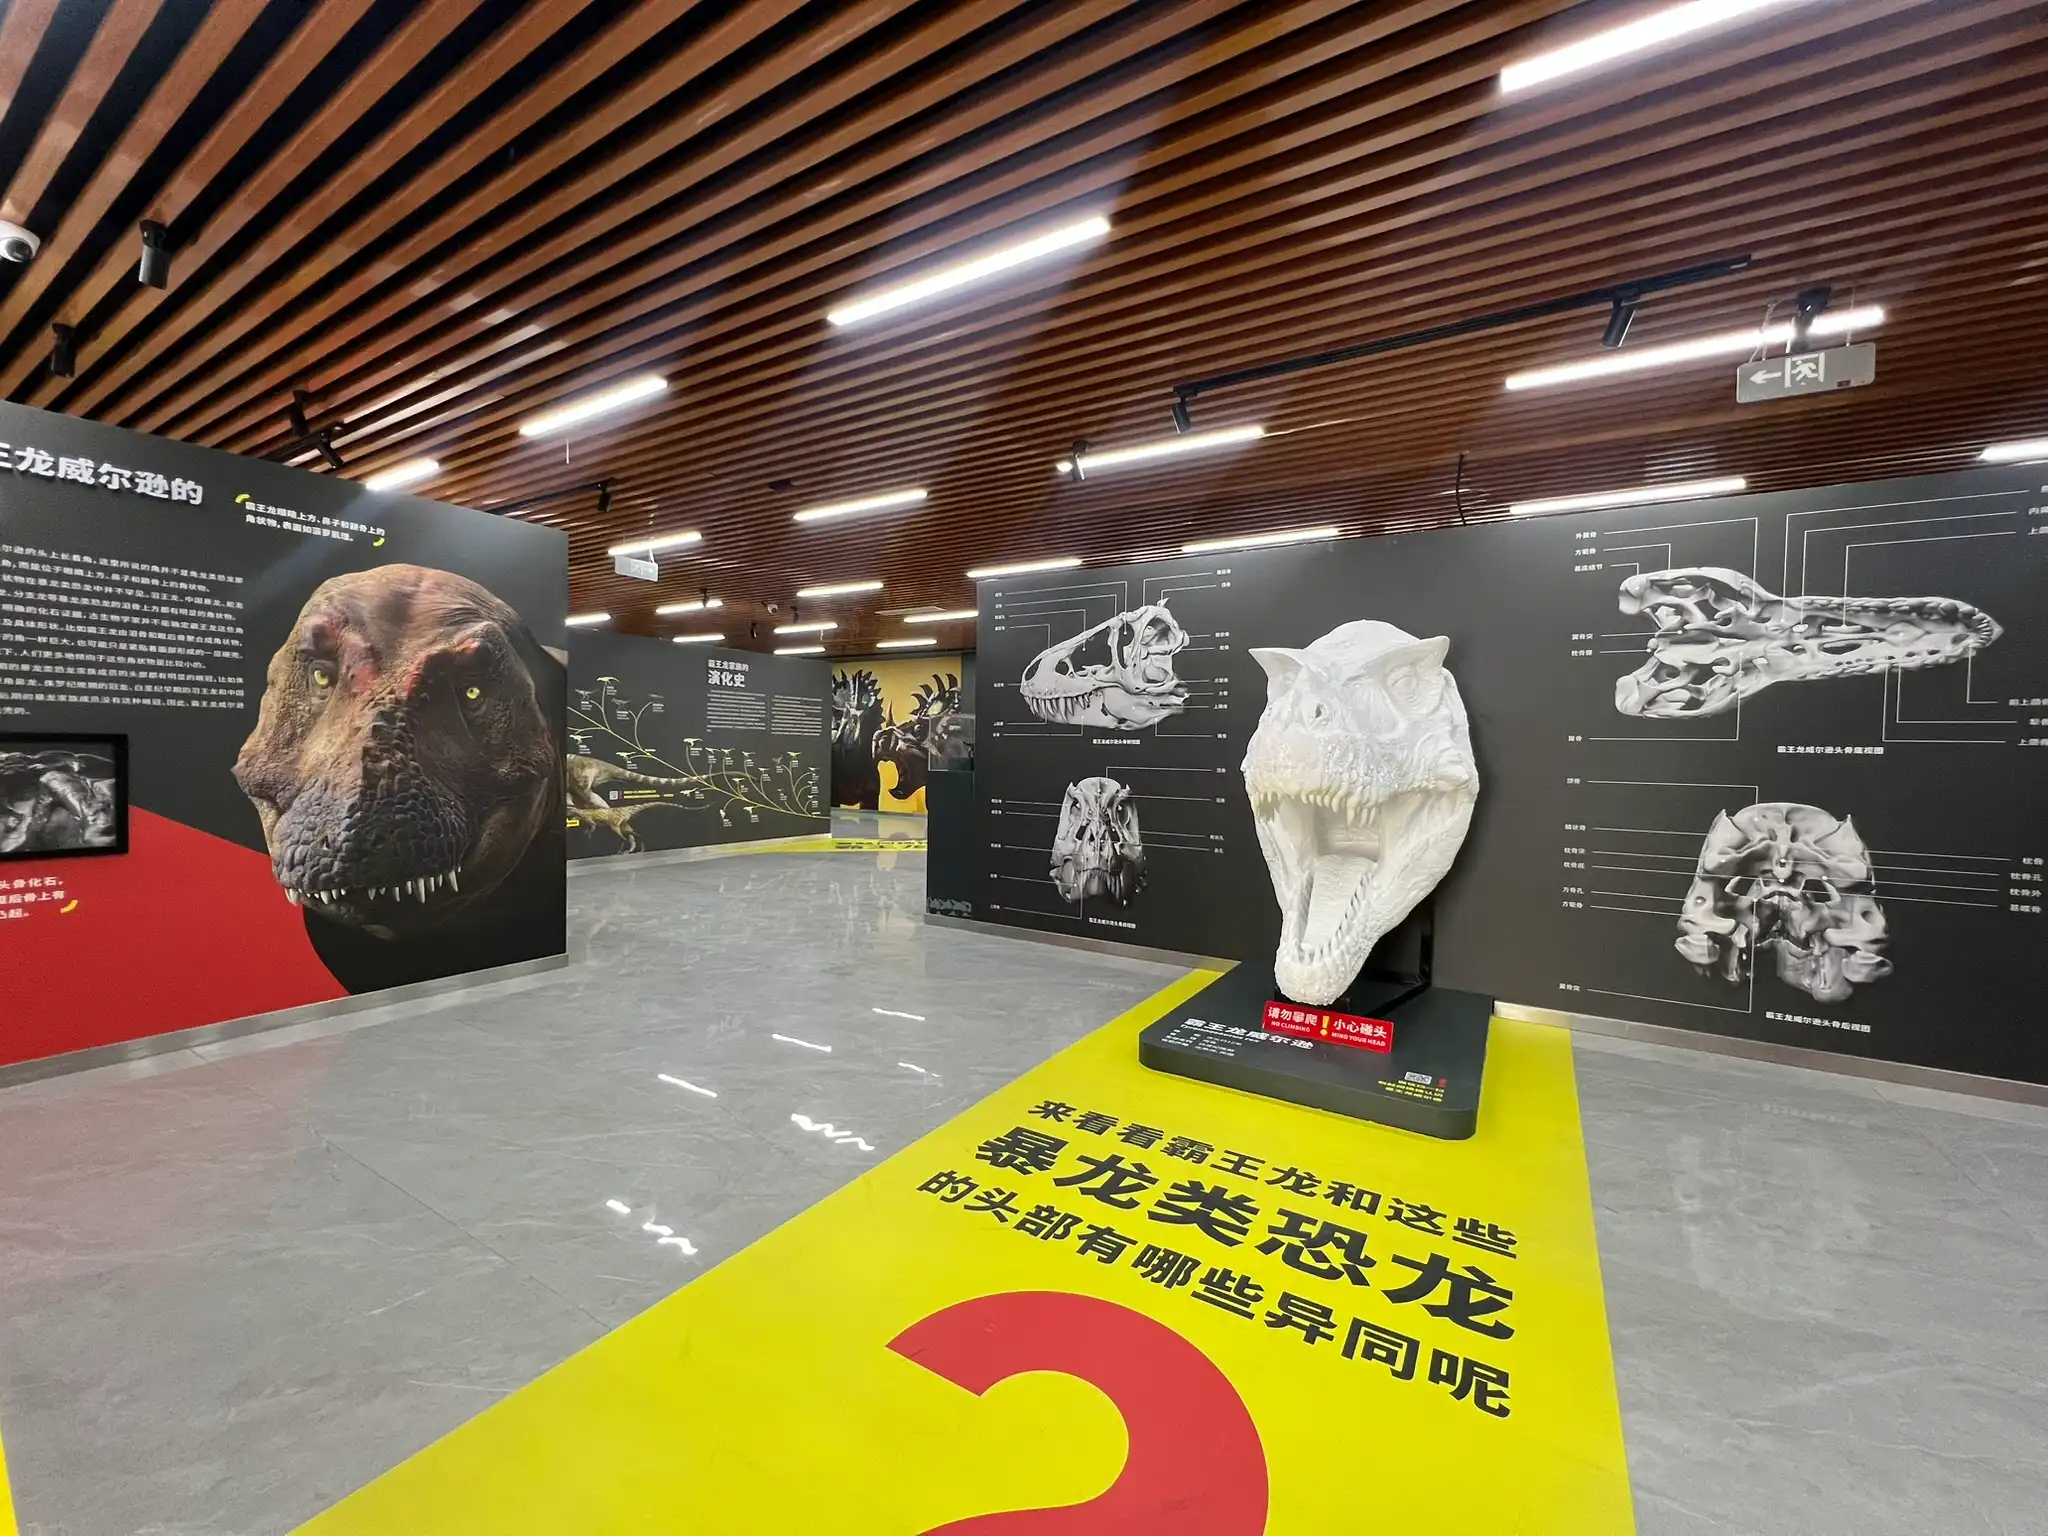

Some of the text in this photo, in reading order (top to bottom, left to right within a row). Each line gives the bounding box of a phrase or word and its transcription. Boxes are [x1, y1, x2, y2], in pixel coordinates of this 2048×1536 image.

[708, 670, 746, 688] 演化史
[1776, 745, 1885, 755] 霸王龙威尔逊头骨底视图
[1183, 1017, 1315, 1050] 霸王龙威尔逊
[1268, 1006, 1318, 1026] 请勿攀爬
[1333, 1018, 1388, 1038] 小心碰头
[1281, 1022, 1311, 1033] CLIMBING
[1765, 1010, 1872, 1033] 霸王龙威尔逊头骨后视图
[1331, 1032, 1386, 1047] MIND YOUR HEAD
[1027, 1099, 1518, 1260] 来看看霸王龙和这些
[975, 1125, 1515, 1341] 暴龙类恐龙
[916, 1169, 1512, 1420] 的头部有哪些异同呢
